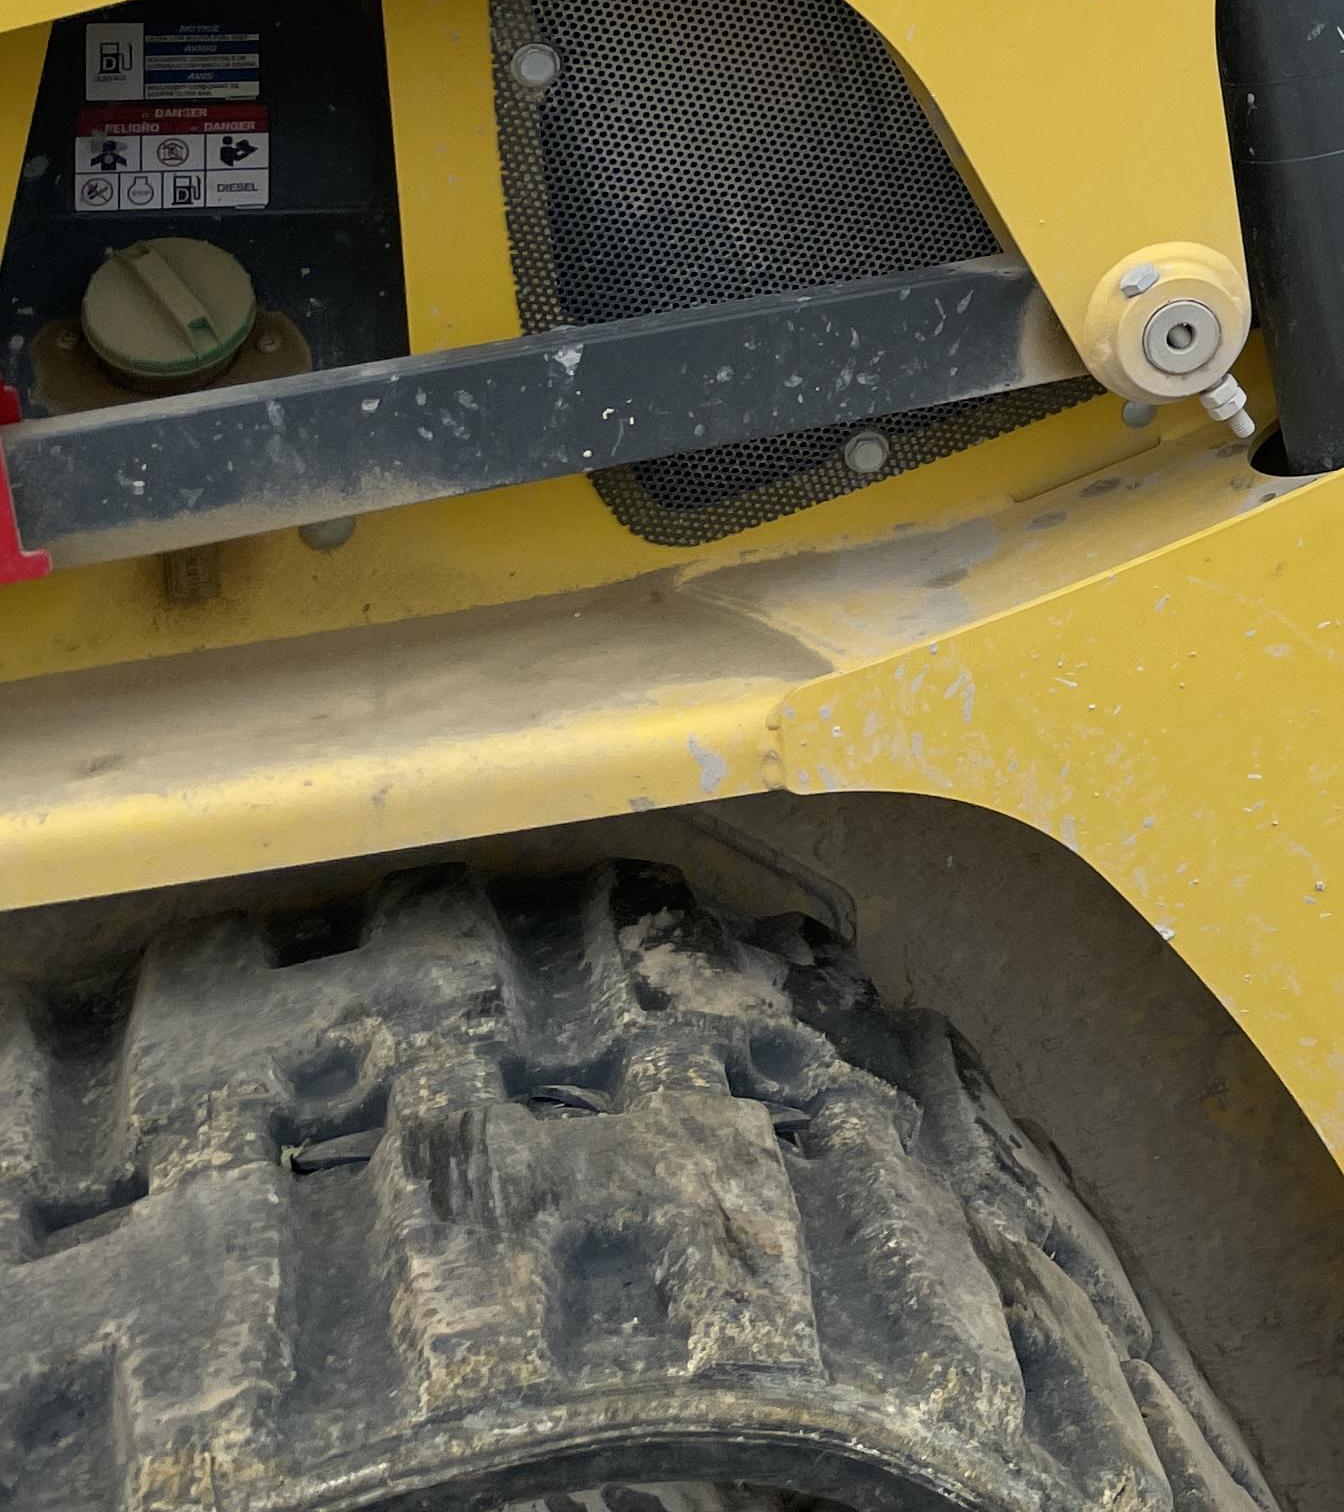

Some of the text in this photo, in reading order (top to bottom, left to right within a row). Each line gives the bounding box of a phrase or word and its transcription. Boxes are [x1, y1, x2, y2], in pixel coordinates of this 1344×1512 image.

[154, 107, 208, 118] DANGER
[203, 121, 256, 131] DANGER
[216, 183, 258, 192] DIESEL
